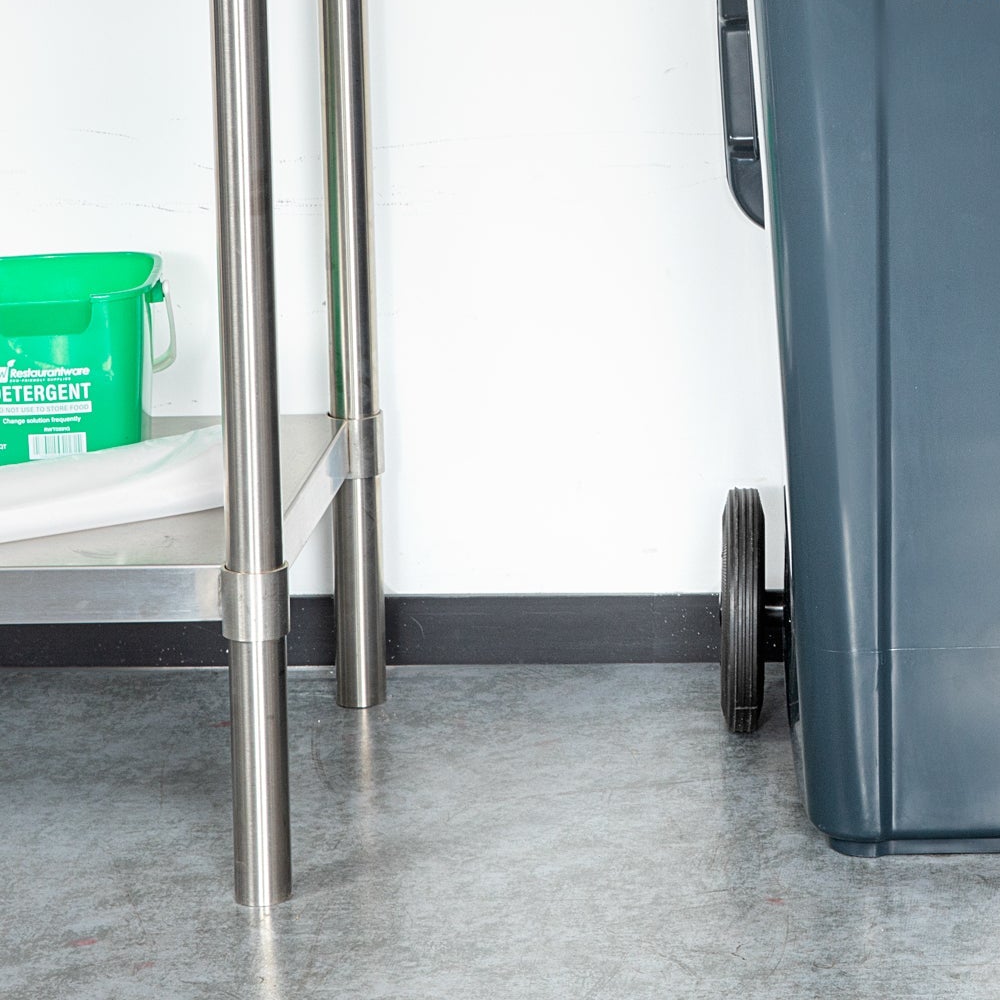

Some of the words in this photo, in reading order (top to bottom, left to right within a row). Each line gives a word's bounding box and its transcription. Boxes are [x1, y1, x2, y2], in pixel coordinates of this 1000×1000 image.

[10, 367, 90, 378] Restaurantware
[0, 382, 91, 402] ETERGENT
[51, 415, 81, 423] frequently
